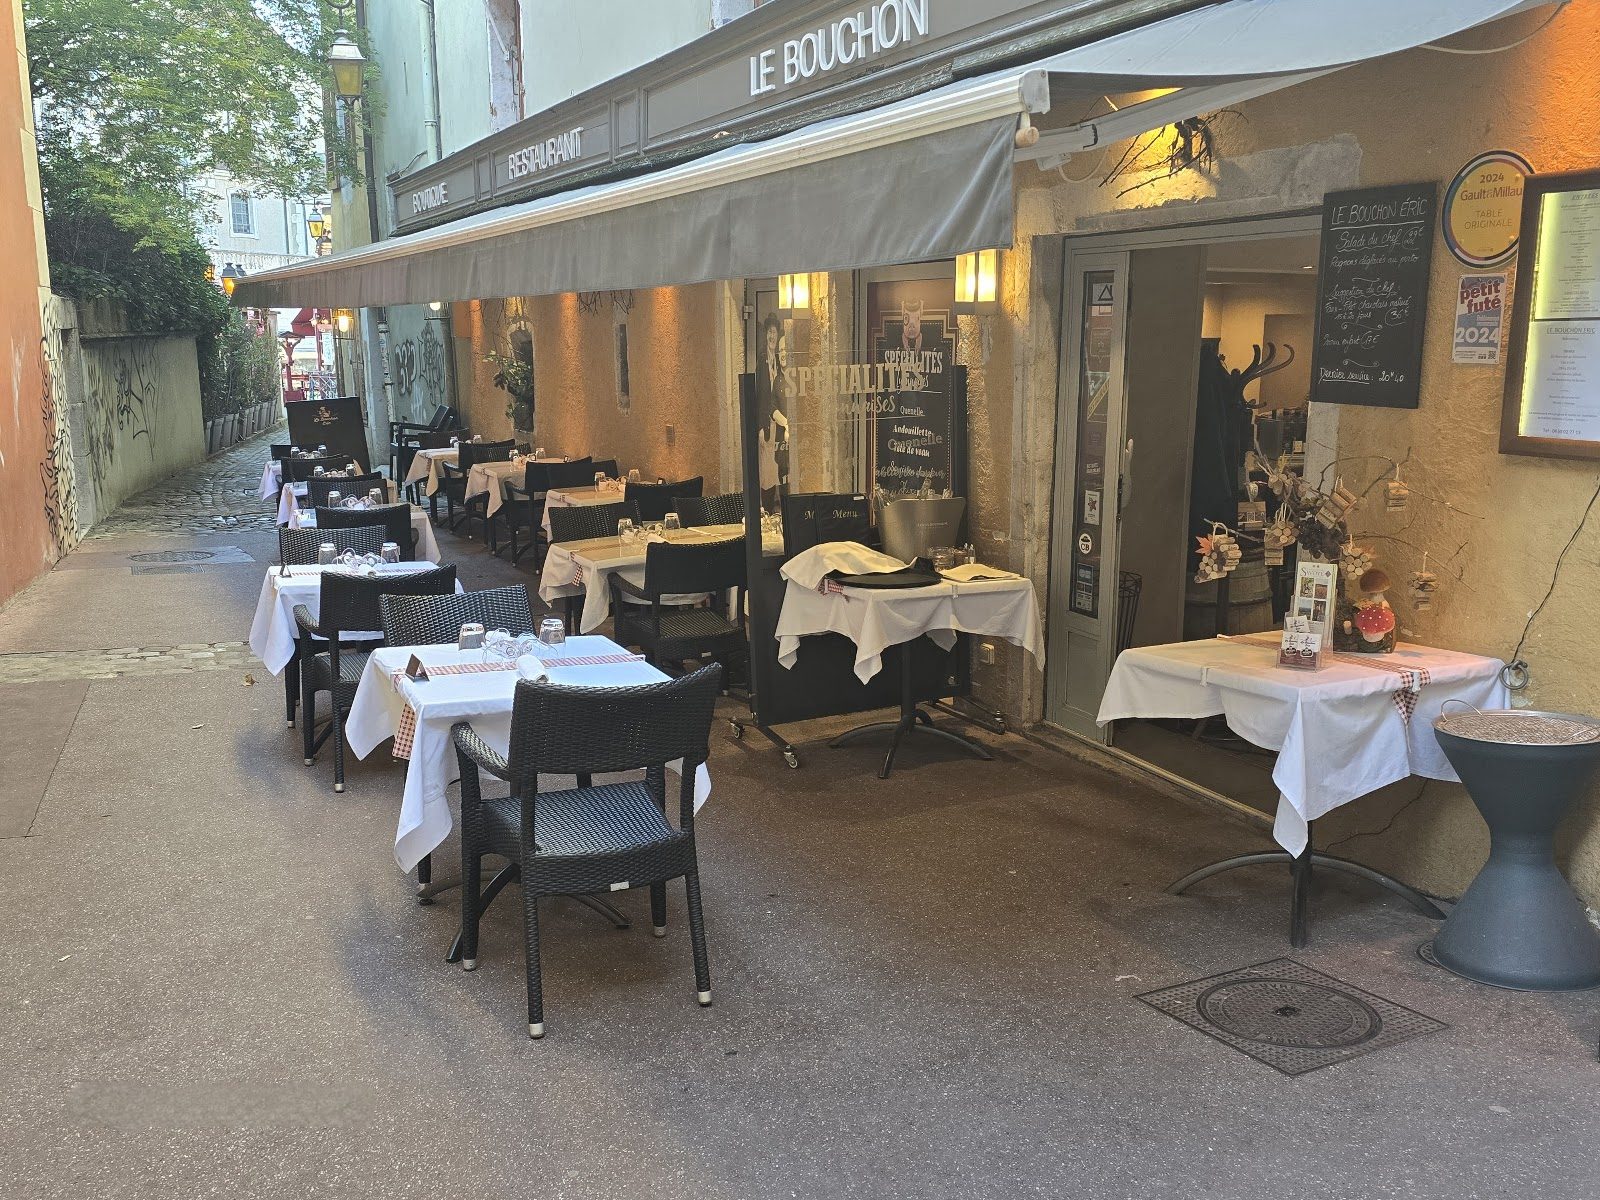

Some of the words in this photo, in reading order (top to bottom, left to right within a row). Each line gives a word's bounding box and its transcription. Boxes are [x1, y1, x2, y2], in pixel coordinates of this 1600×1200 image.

[750, 48, 776, 97] LE
[783, 0, 929, 85] BOUCHON
[508, 126, 584, 180] RESTAURANT
[1480, 173, 1504, 184] 2024
[412, 181, 449, 214] BOUTIQUE
[1331, 205, 1348, 225] LE
[1348, 201, 1397, 224] BOUCHON
[1474, 209, 1503, 218] TABLE
[1464, 219, 1512, 230] ORIGINALE
[1460, 280, 1501, 304] petit
[1467, 295, 1501, 314] futé
[1456, 327, 1500, 343] 2024
[900, 405, 926, 417] Quenelle
[893, 424, 932, 437] Andouillette
[832, 508, 859, 519] Menu
[1080, 543, 1090, 551] CB
